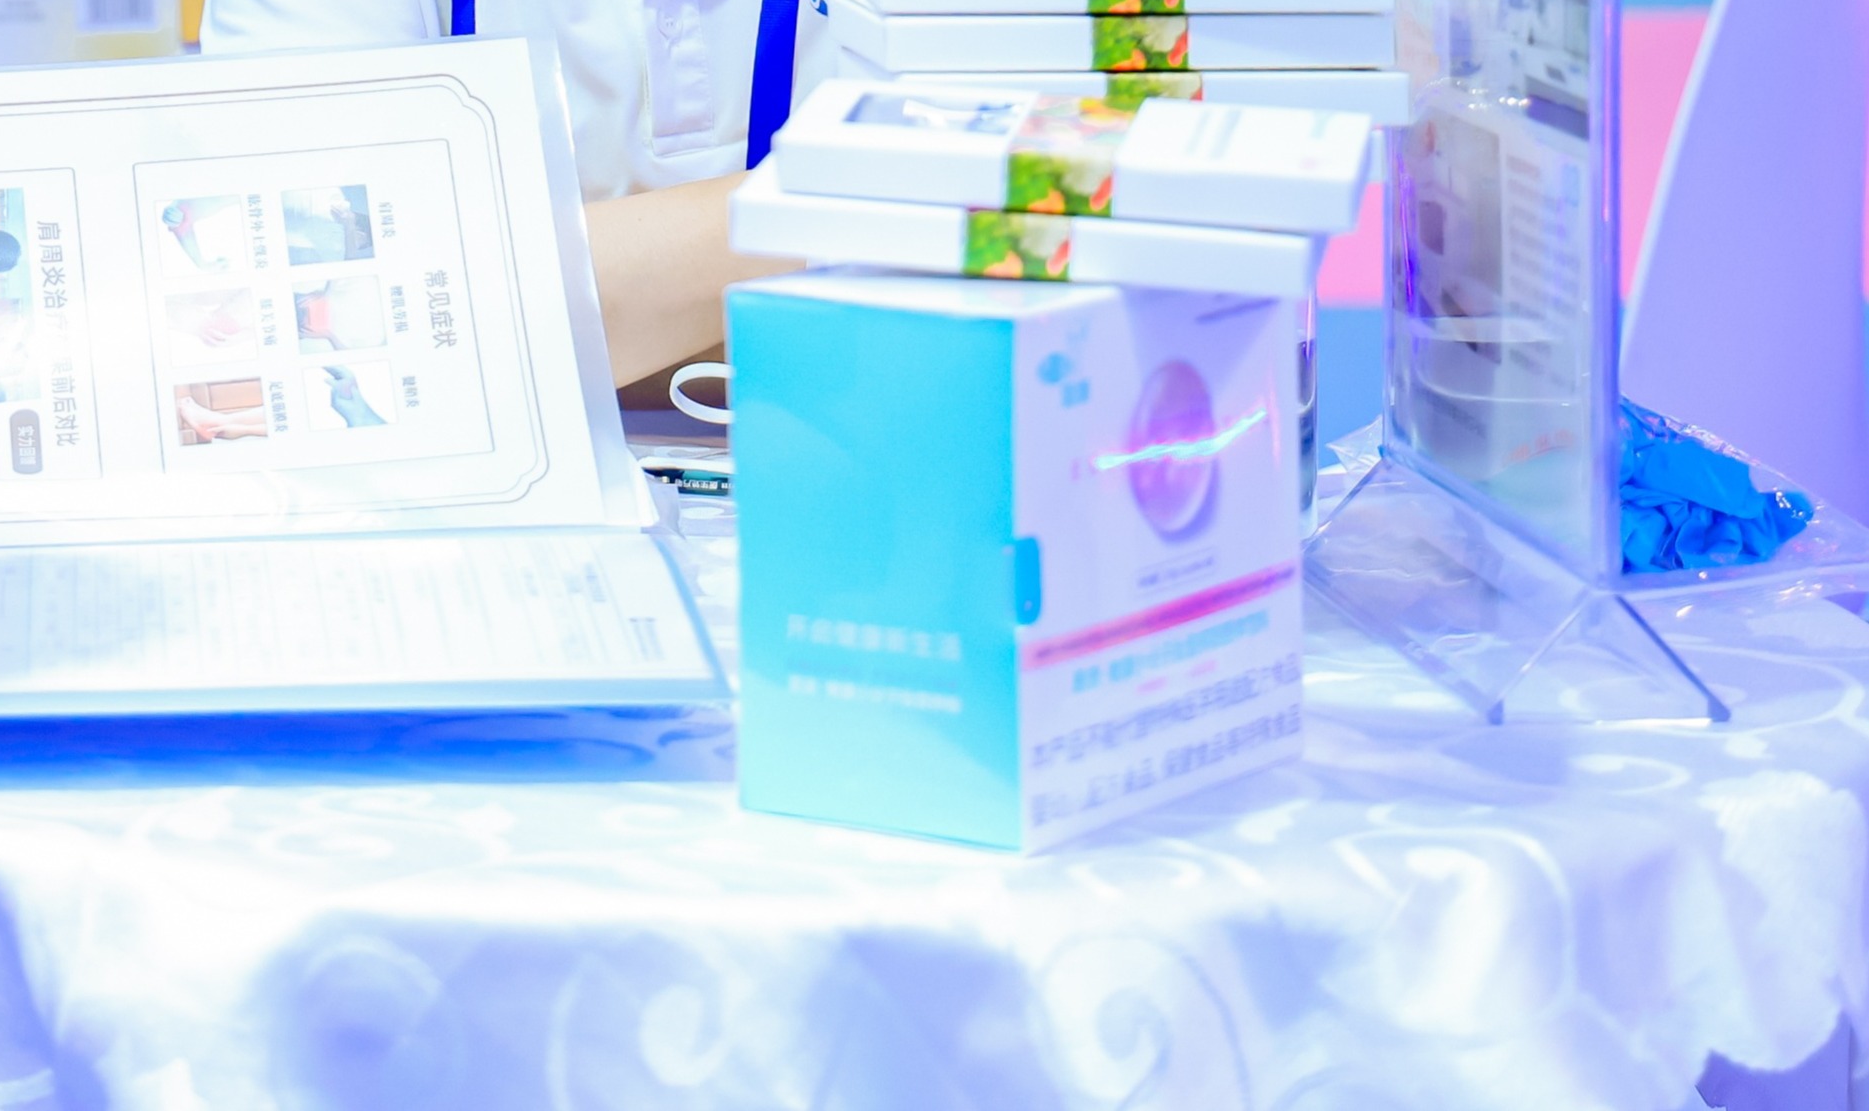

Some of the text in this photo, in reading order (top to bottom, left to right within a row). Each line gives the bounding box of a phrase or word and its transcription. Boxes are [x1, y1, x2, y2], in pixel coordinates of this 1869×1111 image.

[37, 220, 80, 447] 肩周炎治疗果前后对比
[425, 270, 458, 349] 常见症状
